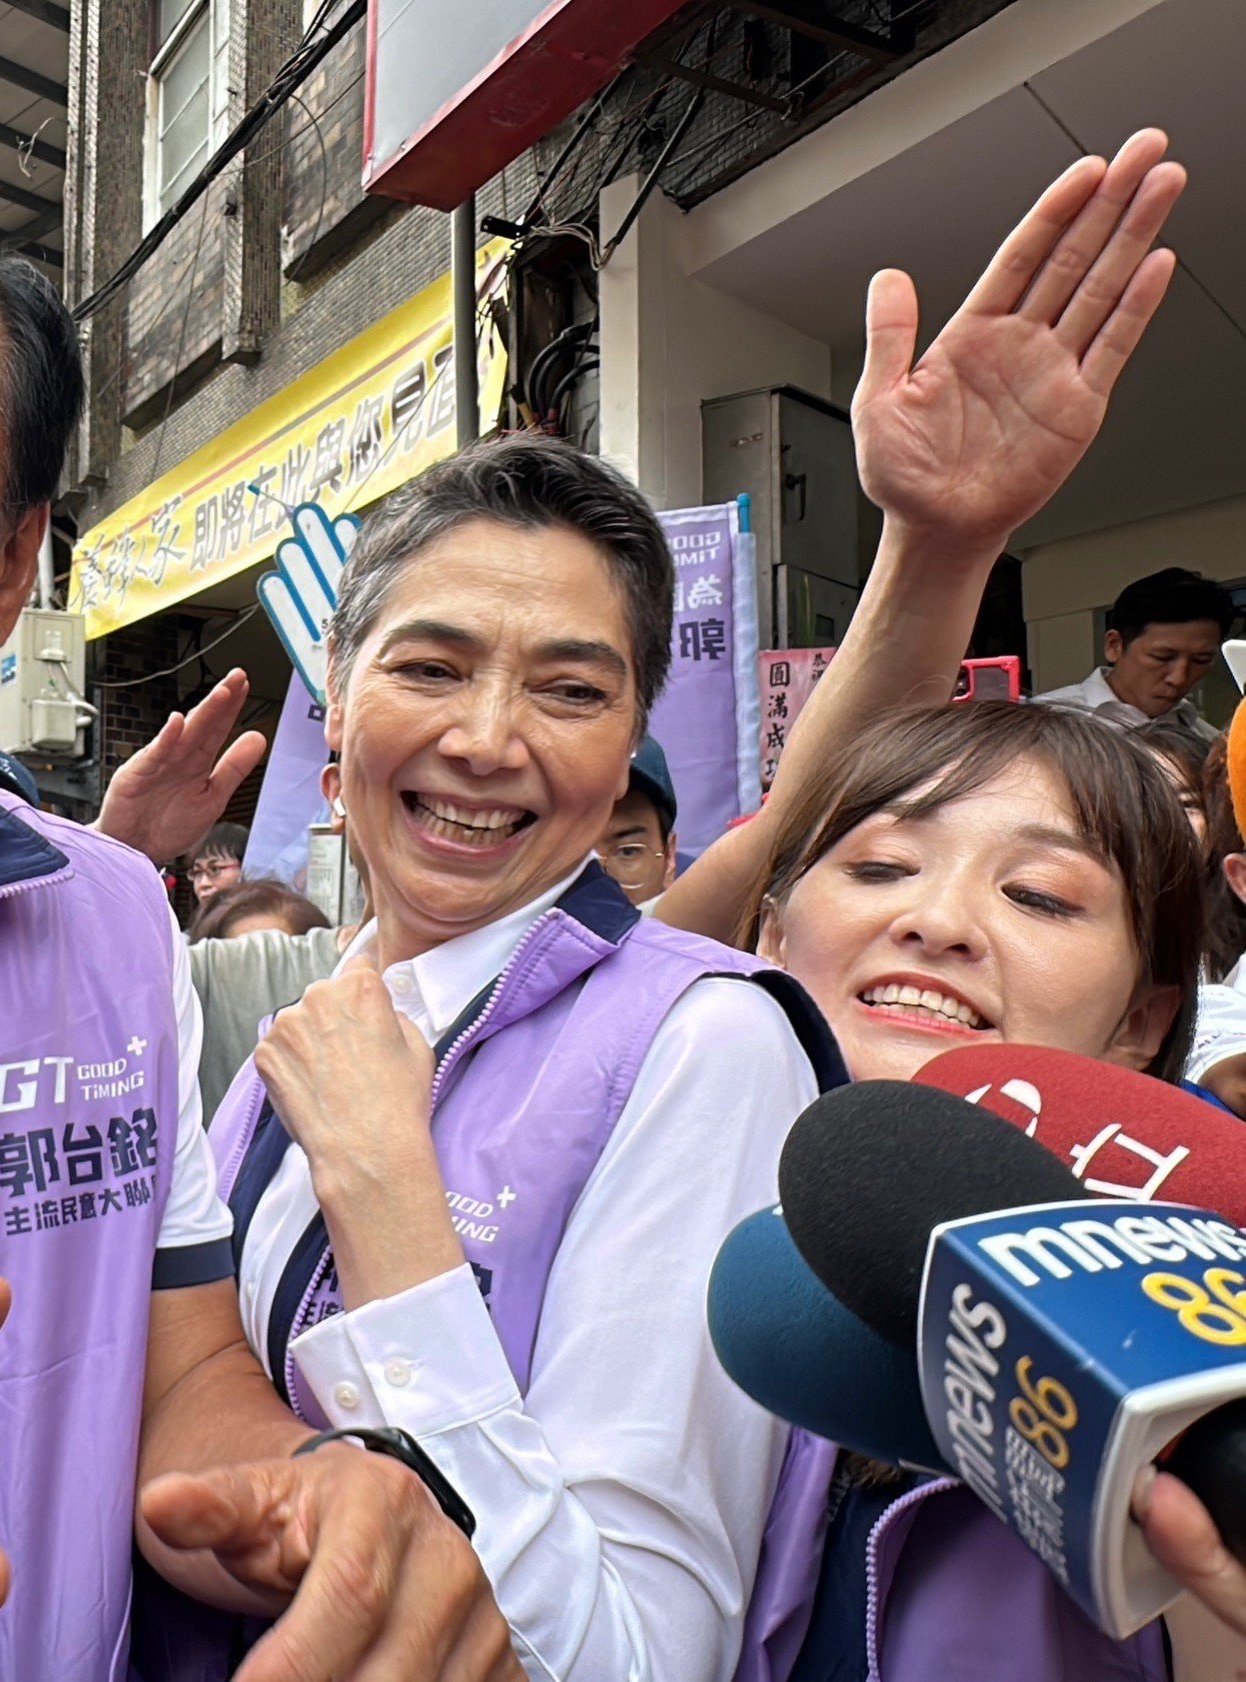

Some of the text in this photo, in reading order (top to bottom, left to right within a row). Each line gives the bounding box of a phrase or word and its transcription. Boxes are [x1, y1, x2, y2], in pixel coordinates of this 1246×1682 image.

[77, 1057, 127, 1080] GOOD
[4, 1174, 157, 1236] 主流民意大聯
[1010, 1355, 1079, 1470] 86
